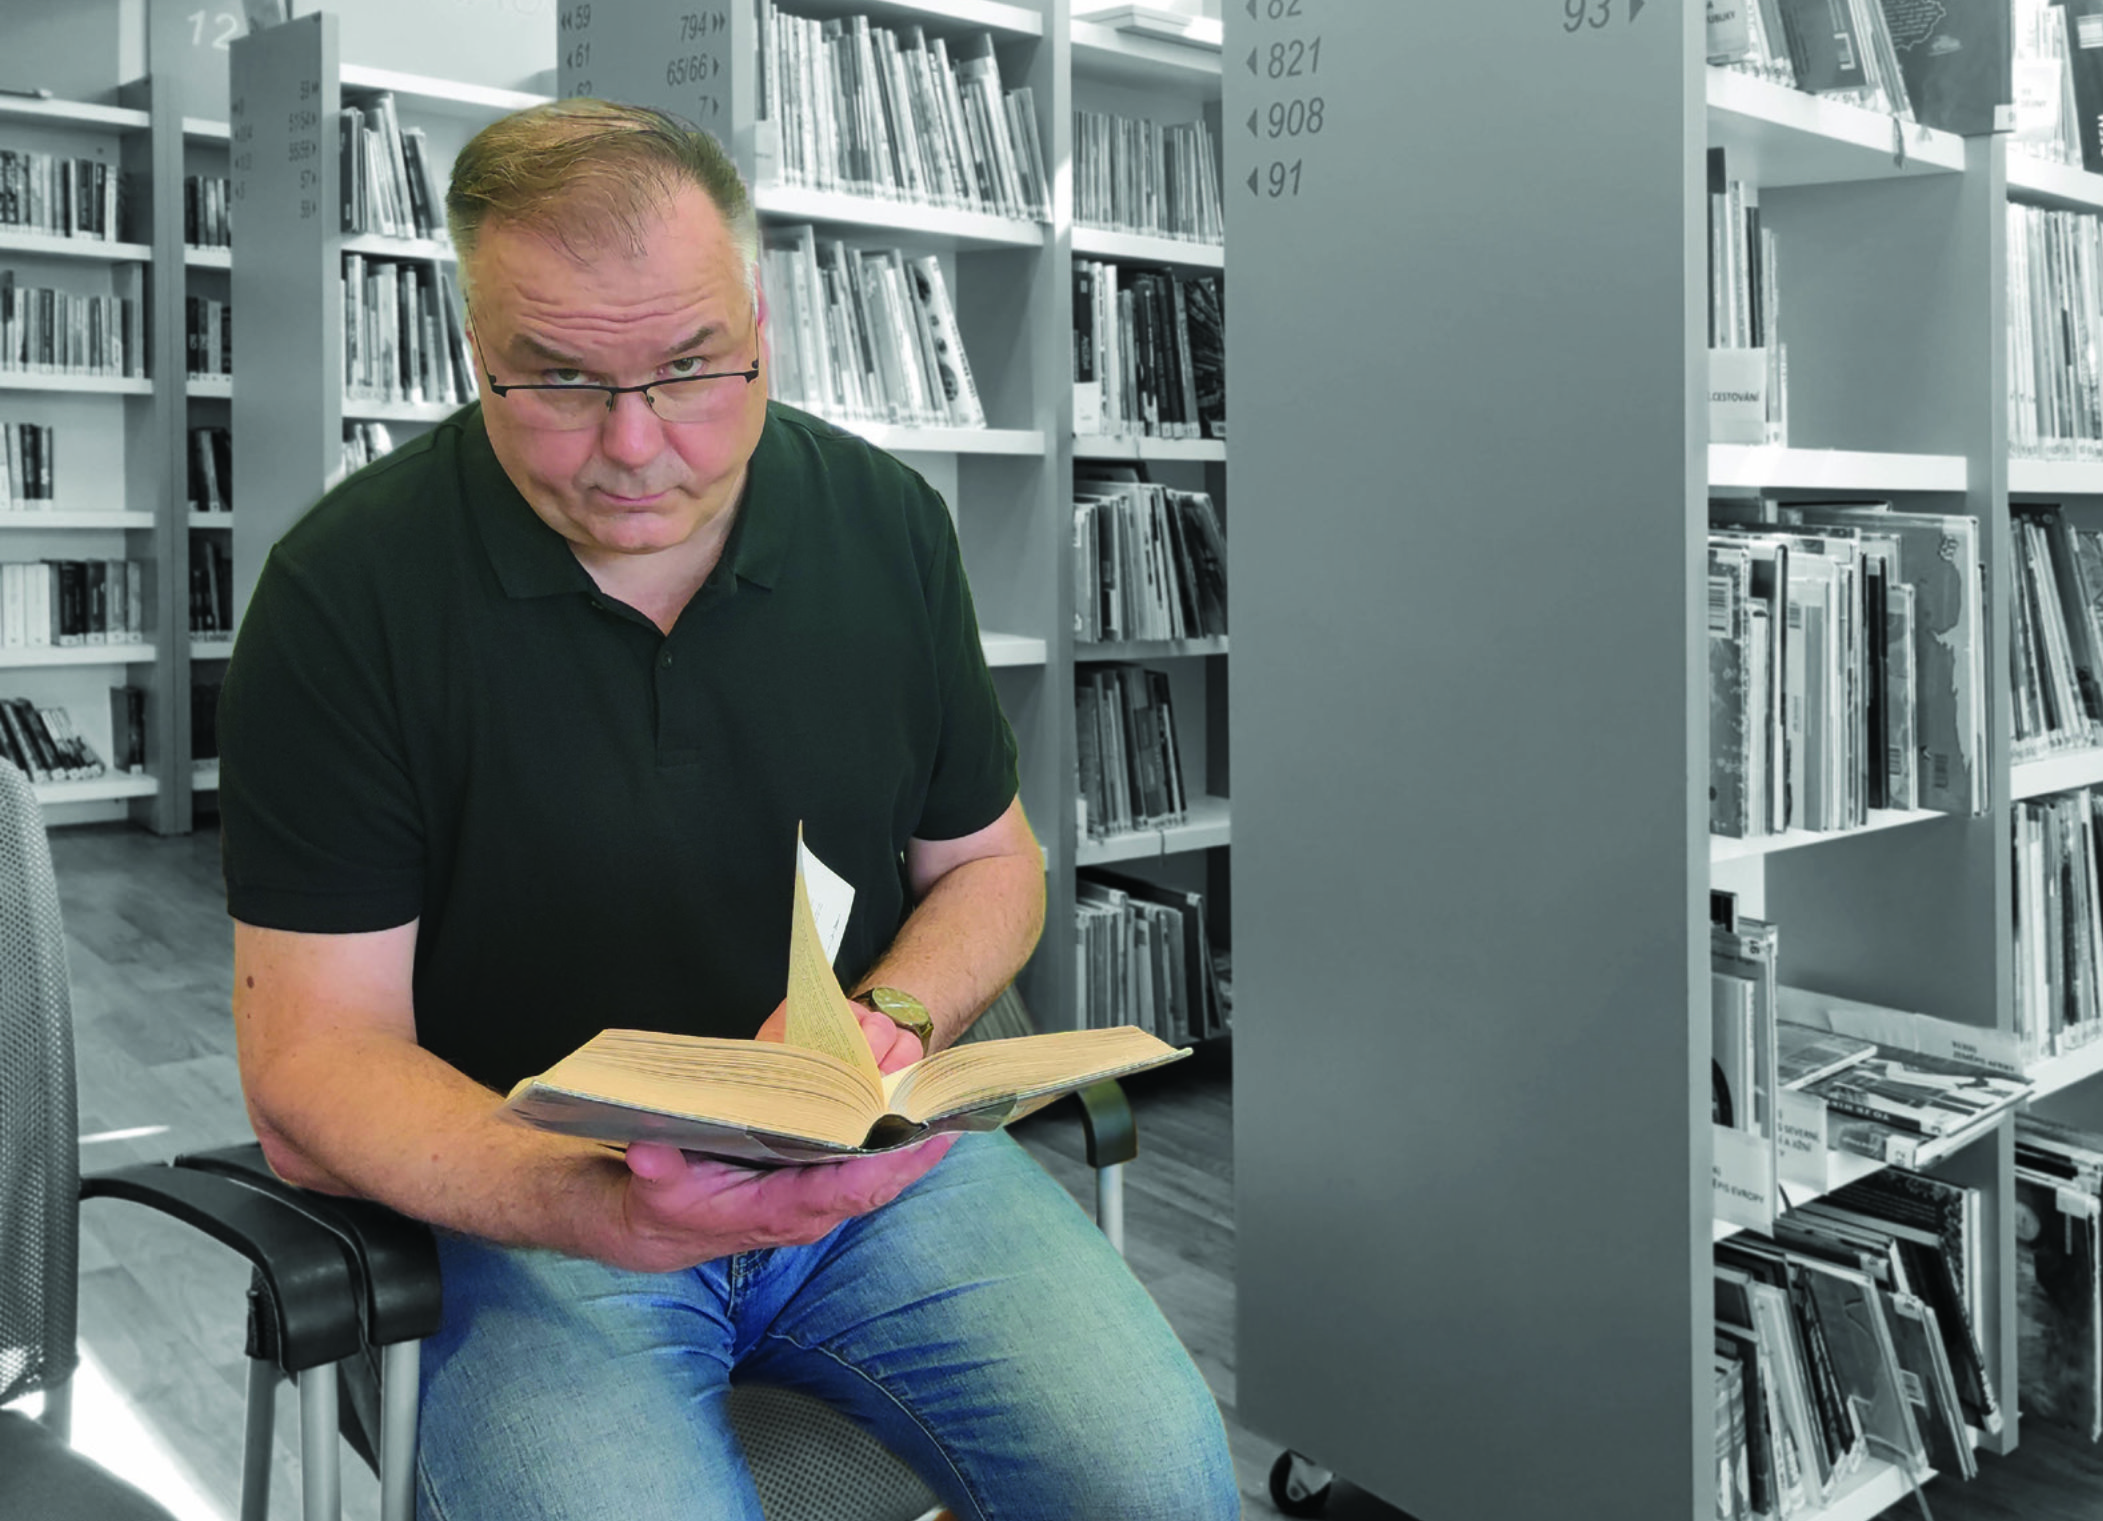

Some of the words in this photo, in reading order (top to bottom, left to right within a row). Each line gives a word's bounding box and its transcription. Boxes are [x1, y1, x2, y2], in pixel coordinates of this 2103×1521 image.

[187, 10, 238, 50] 12
[575, 4, 591, 30] 59
[681, 11, 708, 41] 794
[1563, 0, 1610, 33] 93
[575, 42, 590, 68] 61
[667, 53, 708, 87] 65/66
[1267, 36, 1321, 79] 821
[1268, 97, 1325, 138] 908
[1268, 158, 1302, 197] 91
